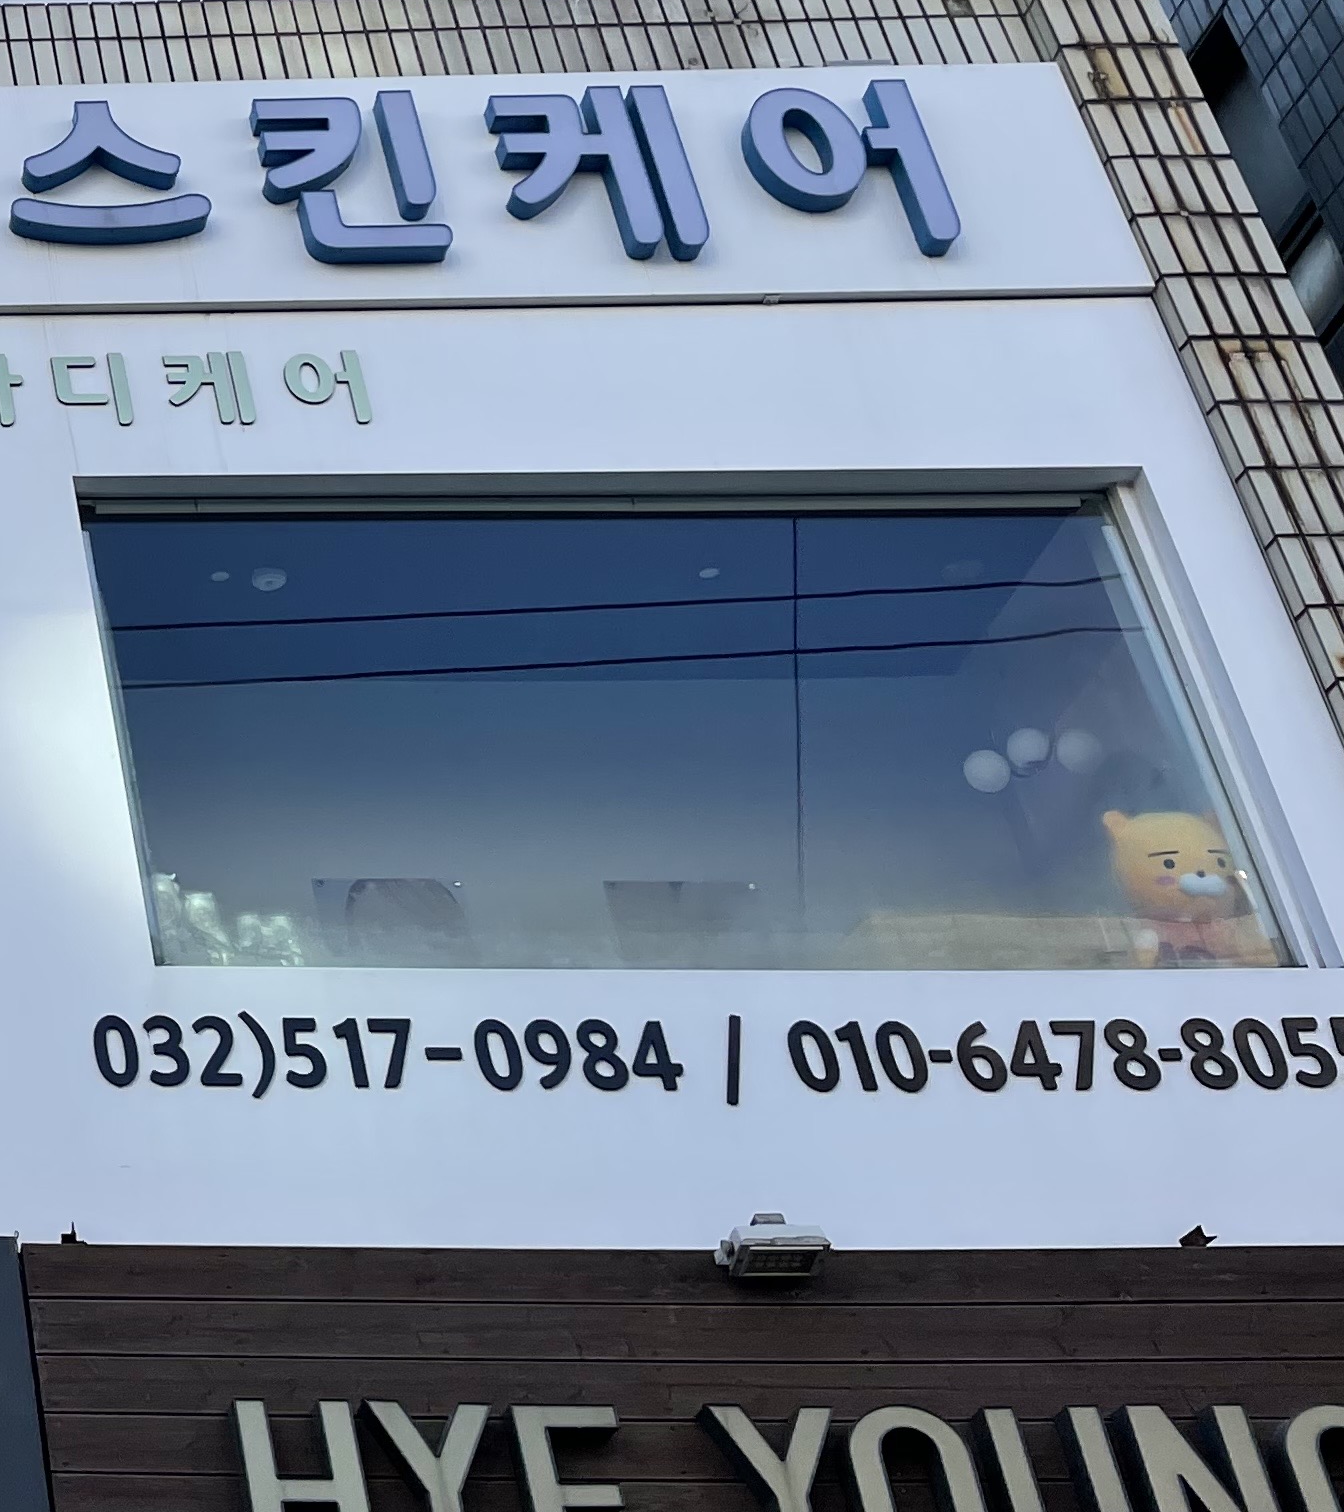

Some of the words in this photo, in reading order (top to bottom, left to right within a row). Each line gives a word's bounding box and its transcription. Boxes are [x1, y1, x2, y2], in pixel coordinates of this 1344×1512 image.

[92, 1010, 685, 1099] 032)517-0984
[787, 1017, 1344, 1092] 010-6478-805
[229, 1398, 626, 1512] HYE
[701, 1403, 1344, 1512] YOUN
